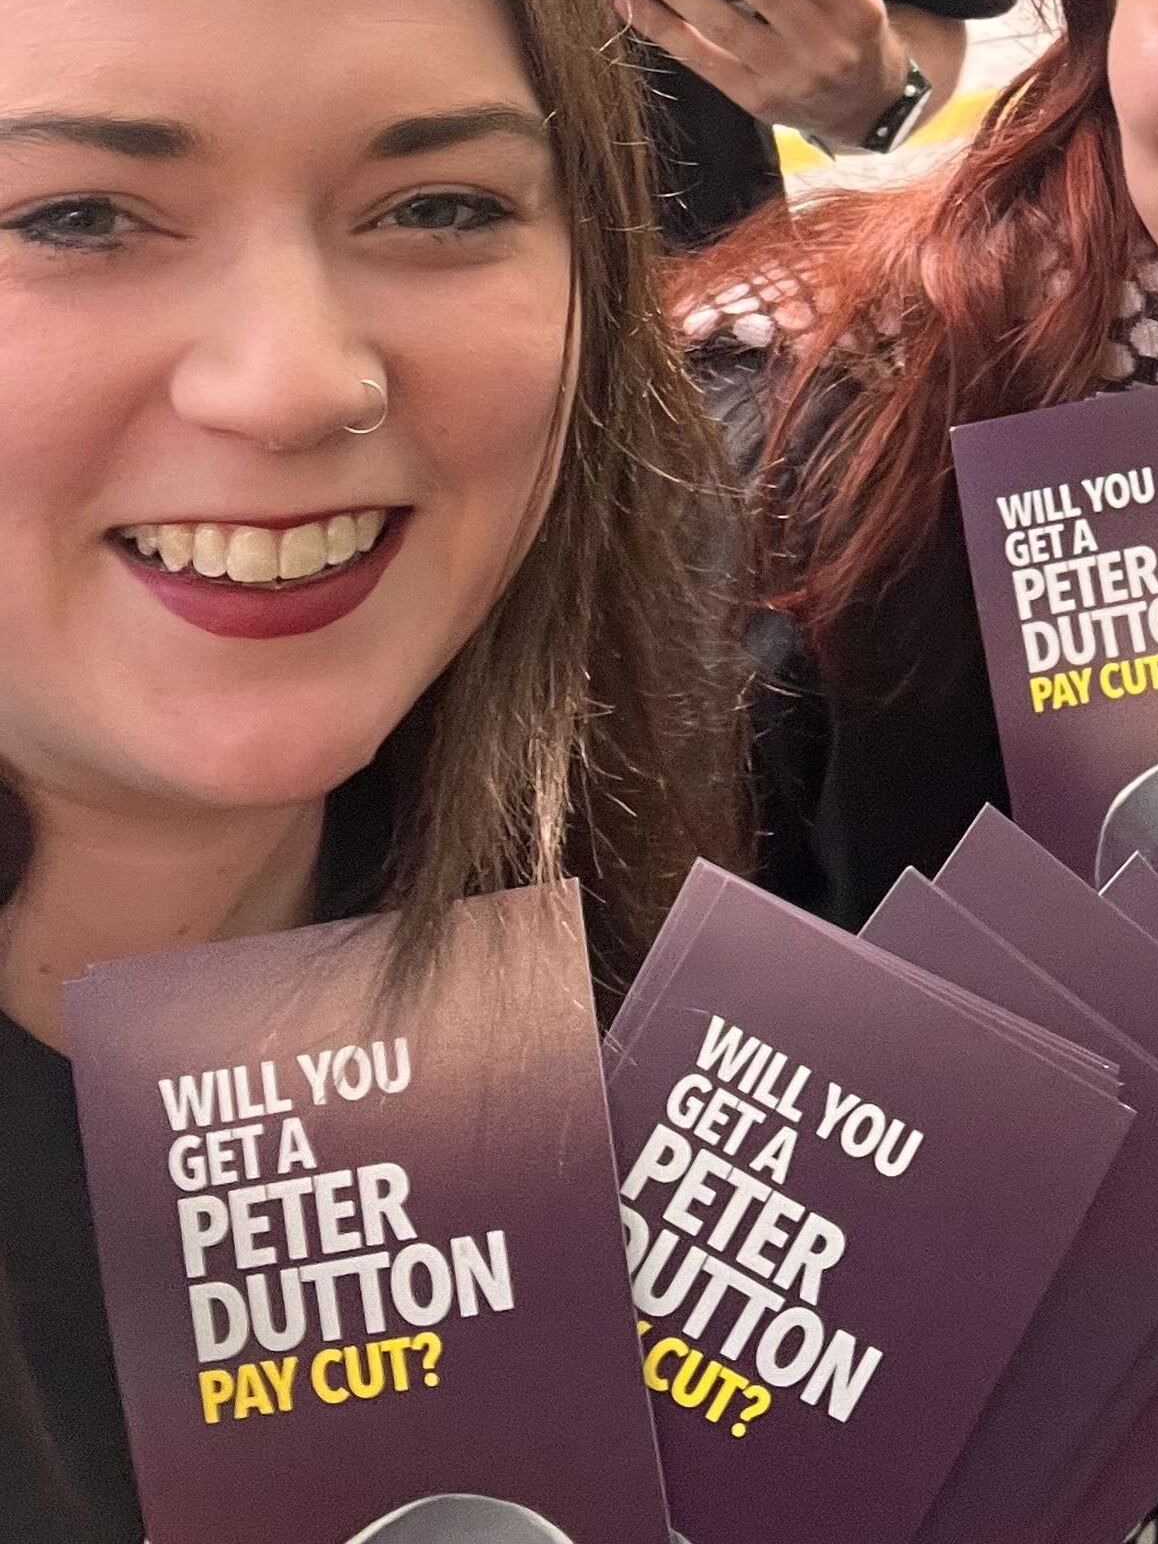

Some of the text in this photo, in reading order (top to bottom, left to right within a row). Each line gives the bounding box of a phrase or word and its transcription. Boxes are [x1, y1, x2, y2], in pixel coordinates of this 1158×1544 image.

[997, 467, 1156, 530] WILL YOU
[1005, 518, 1098, 567] GET A
[1029, 667, 1092, 713] PAY
[158, 1037, 412, 1131] WILL YOU
[666, 1073, 798, 1185] GET A
[696, 1014, 924, 1177] WILL YOU
[167, 1116, 317, 1191] GET A
[176, 1162, 418, 1278] PETER
[620, 1123, 846, 1306] PETER
[188, 1229, 514, 1363] DUTTON
[199, 1331, 442, 1424] PAY CUT?
[643, 1336, 772, 1438] CUT?
